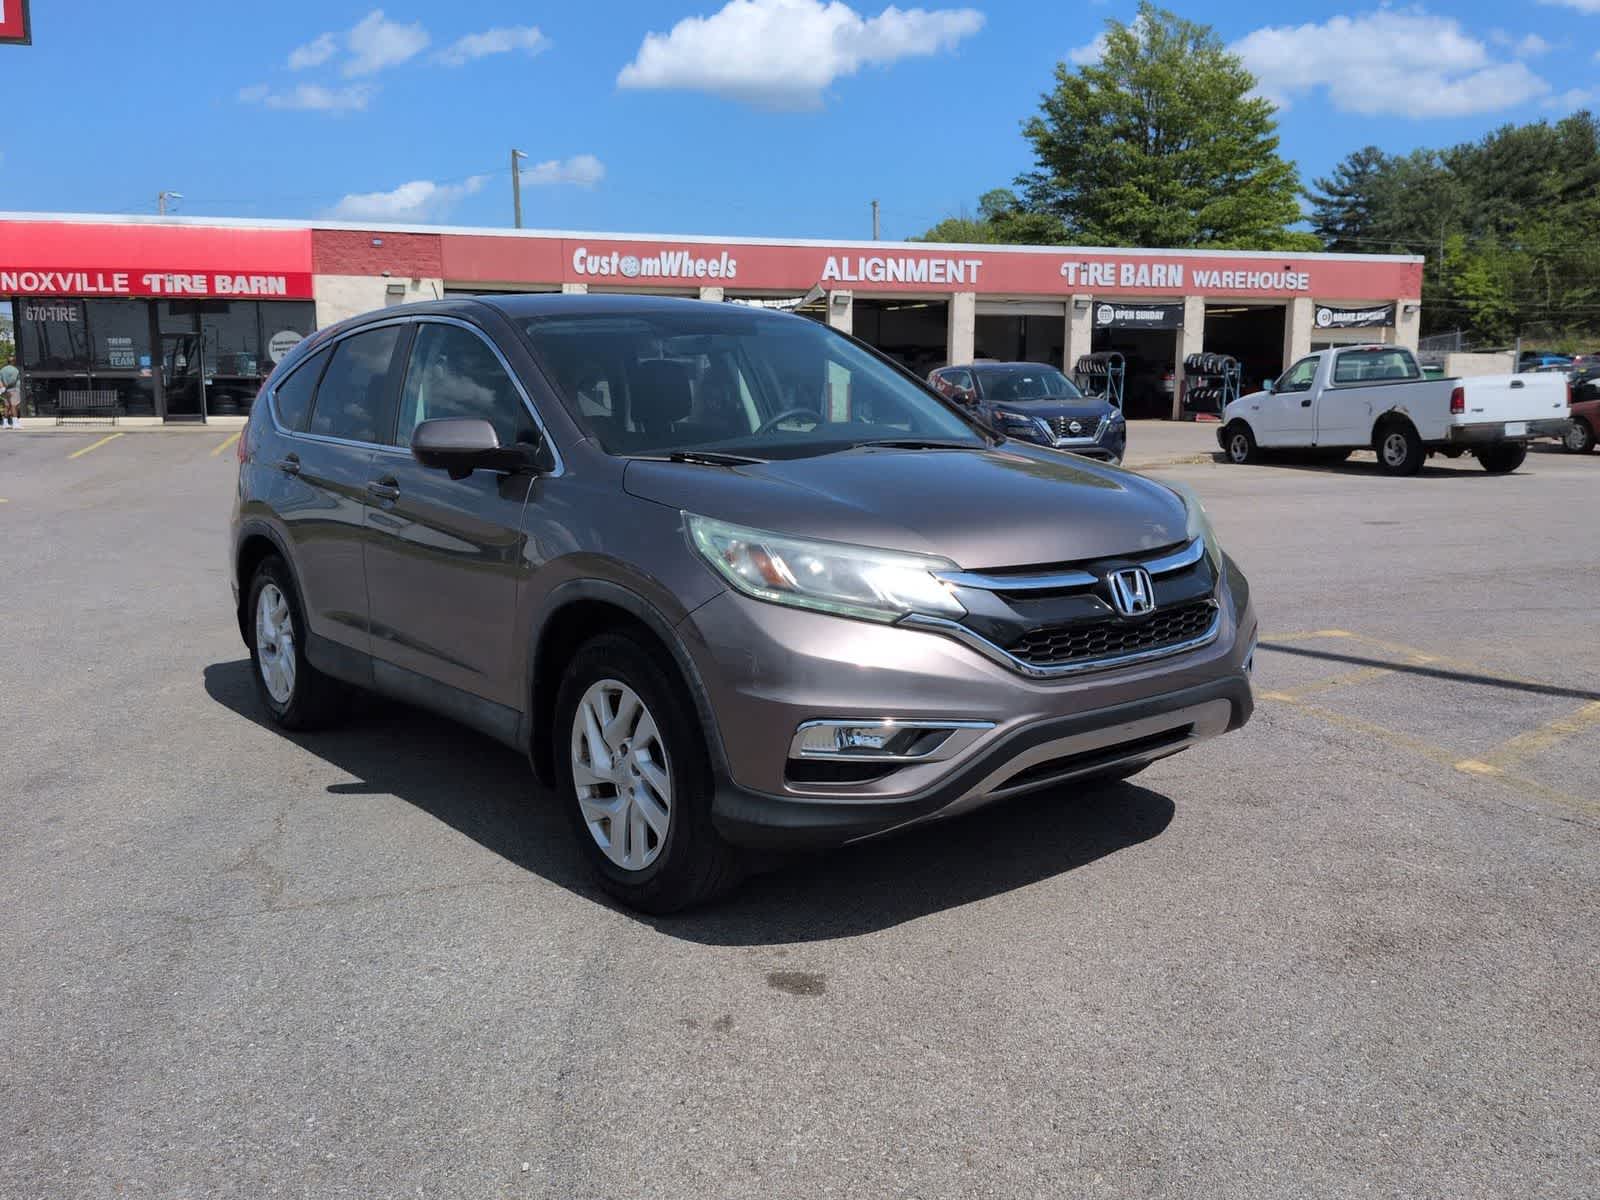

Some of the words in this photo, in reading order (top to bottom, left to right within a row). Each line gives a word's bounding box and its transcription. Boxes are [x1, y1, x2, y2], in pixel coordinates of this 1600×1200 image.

[822, 256, 982, 284] ALIGNMENT
[1120, 263, 1184, 288] BARN
[1192, 270, 1310, 291] WAREHOUSE
[214, 275, 287, 295] BARN
